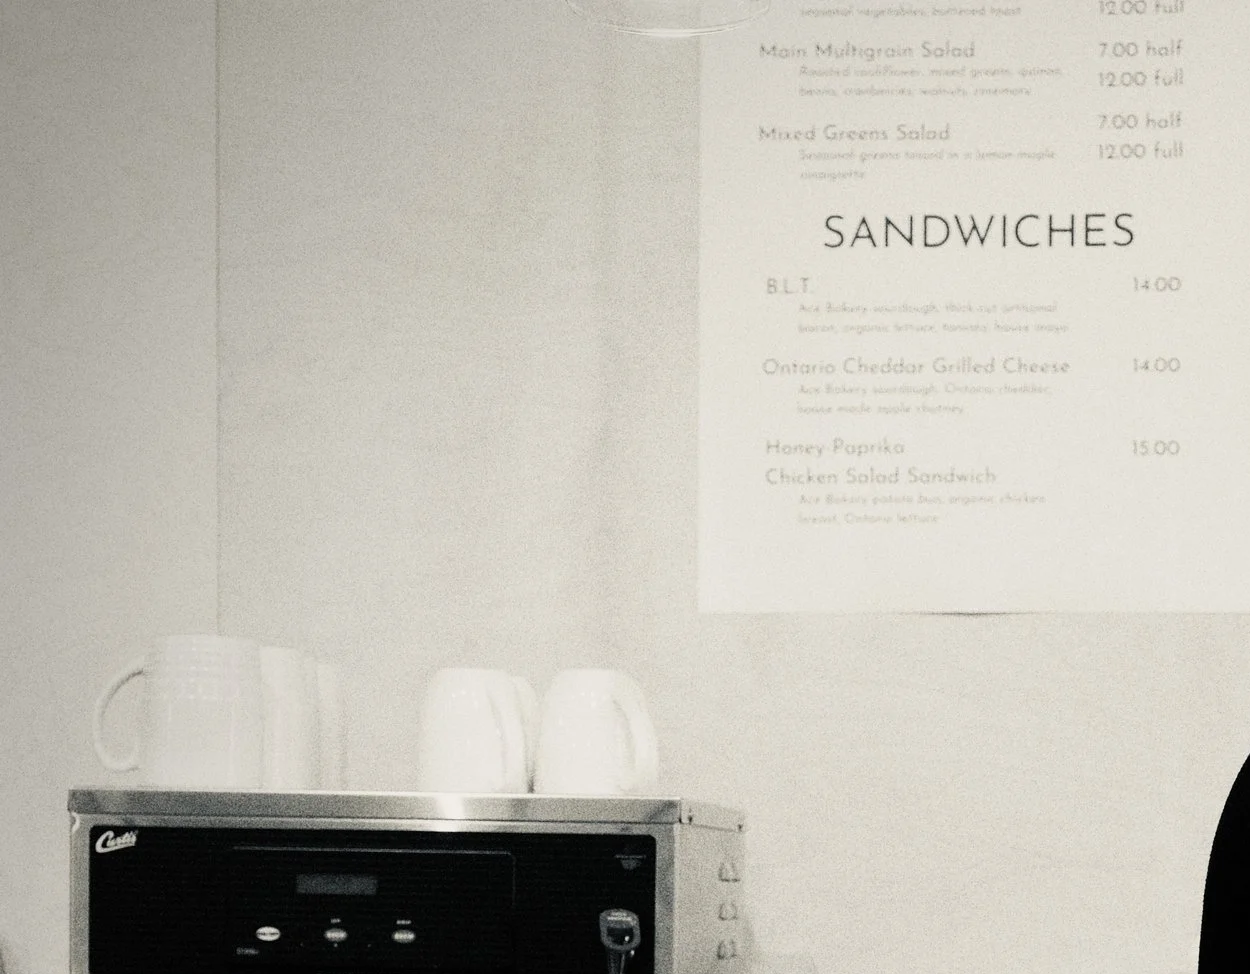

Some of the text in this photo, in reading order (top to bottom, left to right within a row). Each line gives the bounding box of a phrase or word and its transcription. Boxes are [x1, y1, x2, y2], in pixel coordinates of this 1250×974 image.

[1099, 0, 1184, 15] 12.00 full
[759, 41, 975, 62] Main Multigrain Salad
[1099, 39, 1183, 57] 7.00 half
[1099, 68, 1183, 88] 12.00 full
[1099, 112, 1182, 130] 7.00 half
[759, 123, 950, 141] Mixed Greens Salad
[1099, 141, 1183, 160] 12.00 full
[824, 213, 1134, 248] SANDWICHES
[1133, 276, 1182, 292] 14.00
[762, 357, 1070, 375] Ontario Cheddar Grilled Cheese
[1133, 357, 1181, 373] 14.00
[1133, 440, 1180, 456] 15.00
[765, 467, 996, 485] Chicken Salad Sandwich
